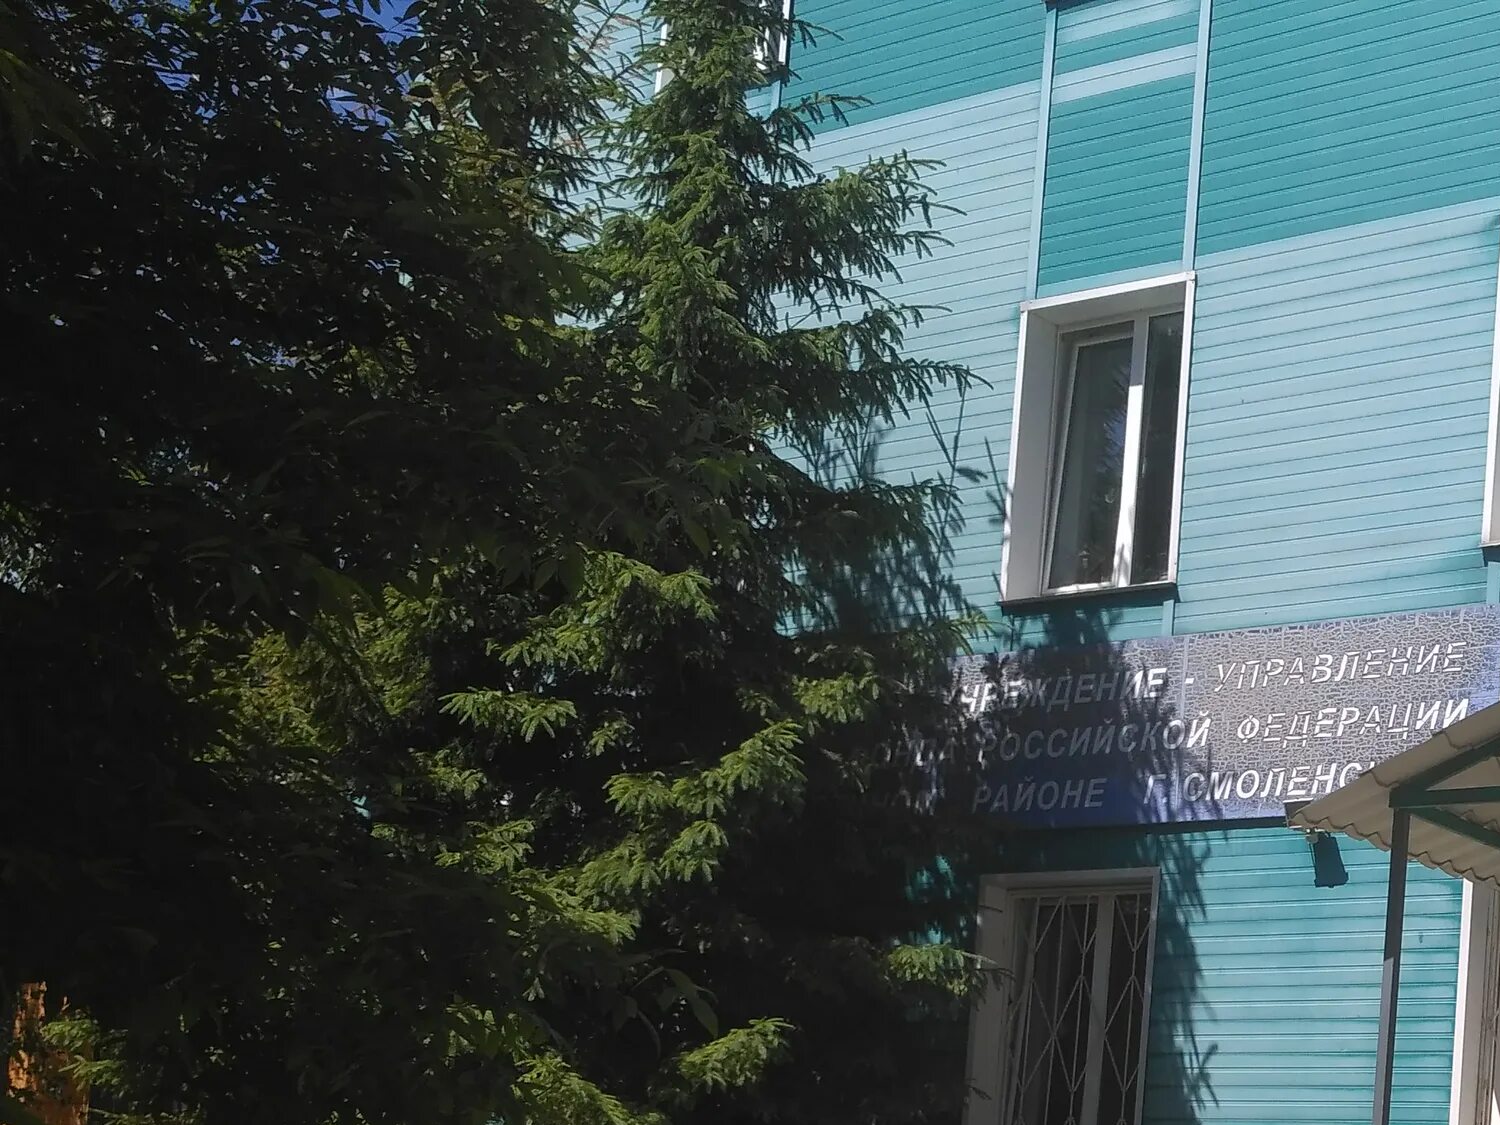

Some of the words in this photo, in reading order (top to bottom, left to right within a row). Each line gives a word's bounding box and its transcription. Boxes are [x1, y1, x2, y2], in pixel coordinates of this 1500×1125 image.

[1213, 641, 1467, 692] УПРАВЛЕНИЕ
[979, 711, 1212, 762] РОССИЙСКОЙ
[1236, 699, 1469, 748] ФЕДЕРАЦИИ
[971, 775, 1108, 814] РАЙОНЕ
[1183, 761, 1376, 801] СМОЛЕНС
